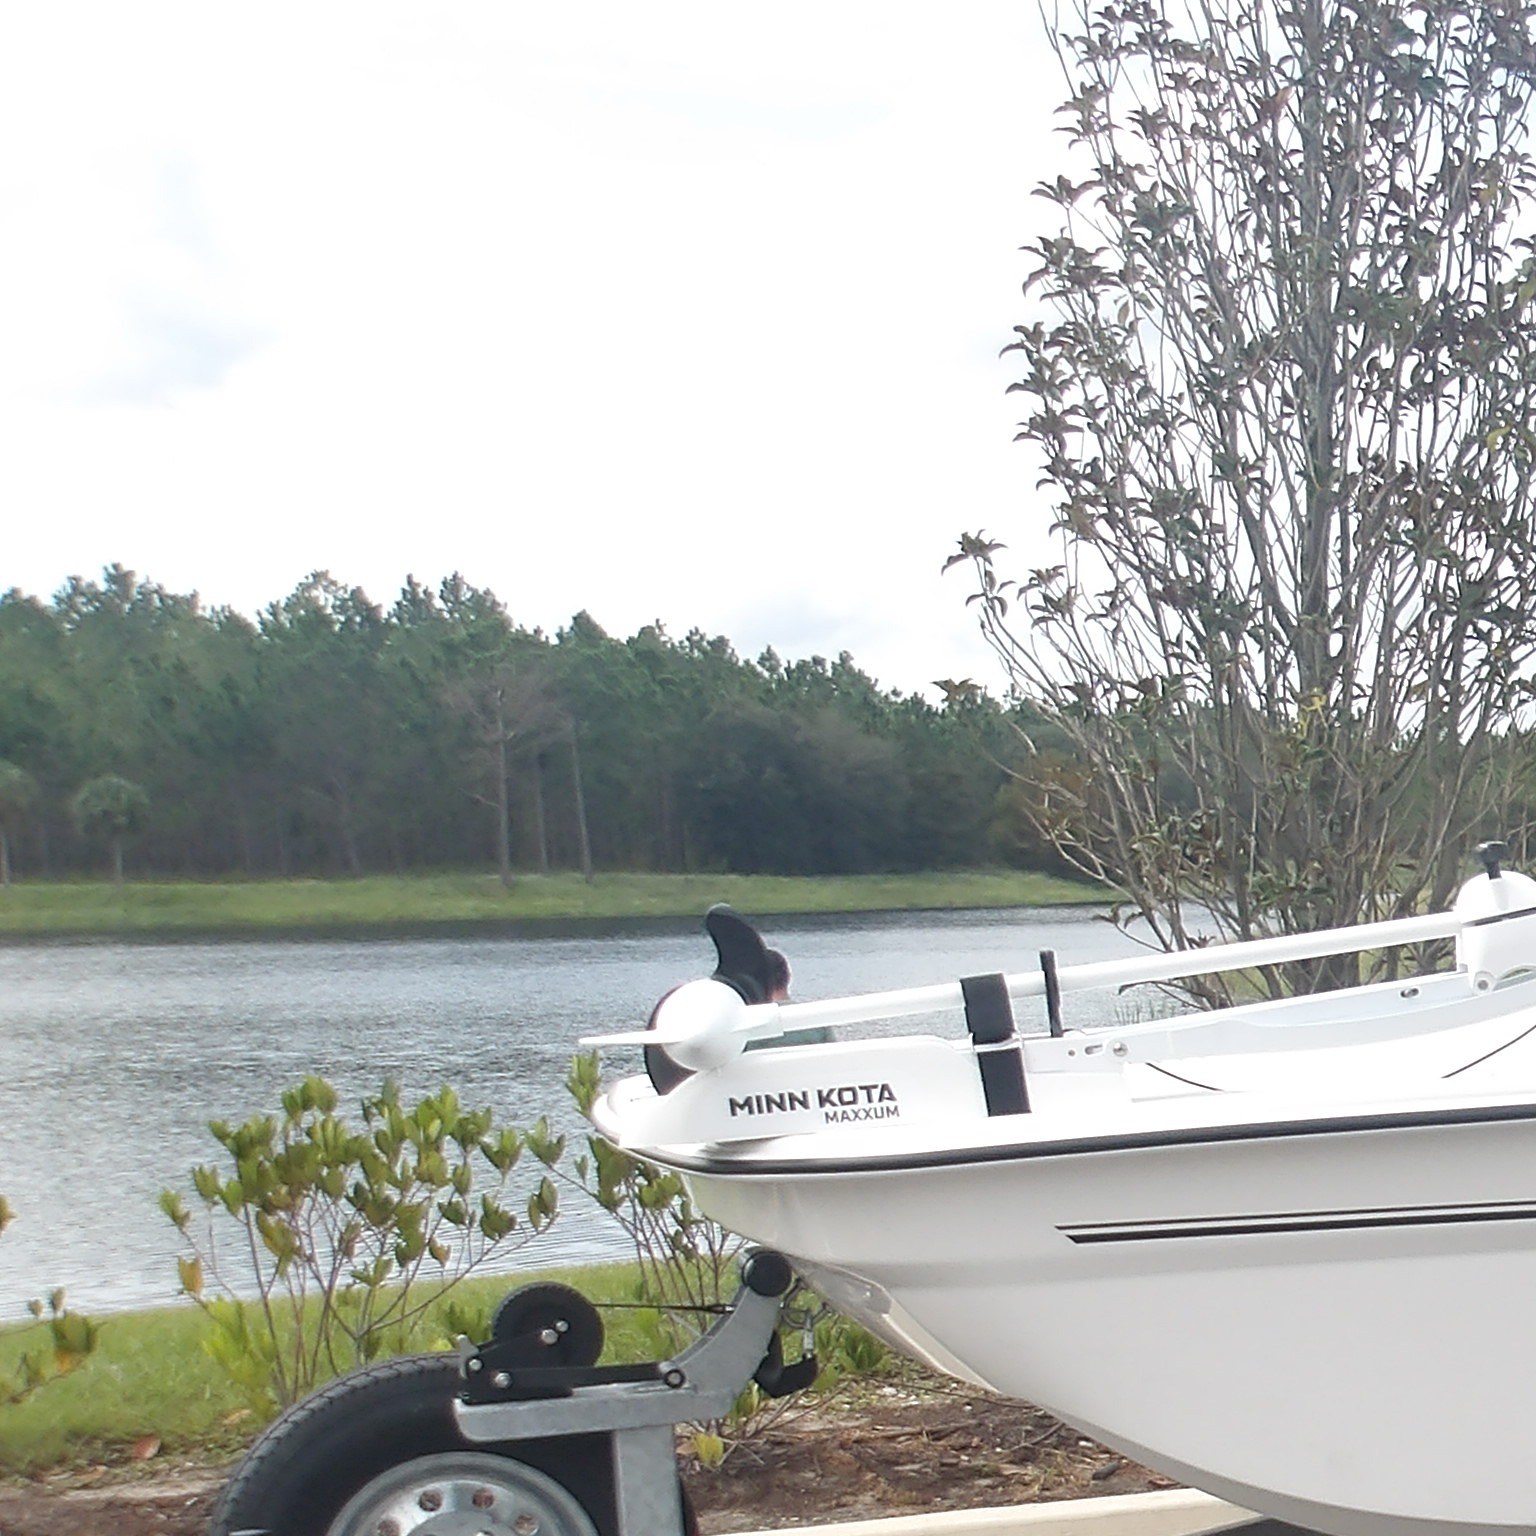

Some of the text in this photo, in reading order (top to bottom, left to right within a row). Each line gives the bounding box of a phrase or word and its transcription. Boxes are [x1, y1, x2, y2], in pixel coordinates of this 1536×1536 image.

[728, 1083, 898, 1117] MINN KOTA
[824, 1105, 901, 1125] MAXXUM
